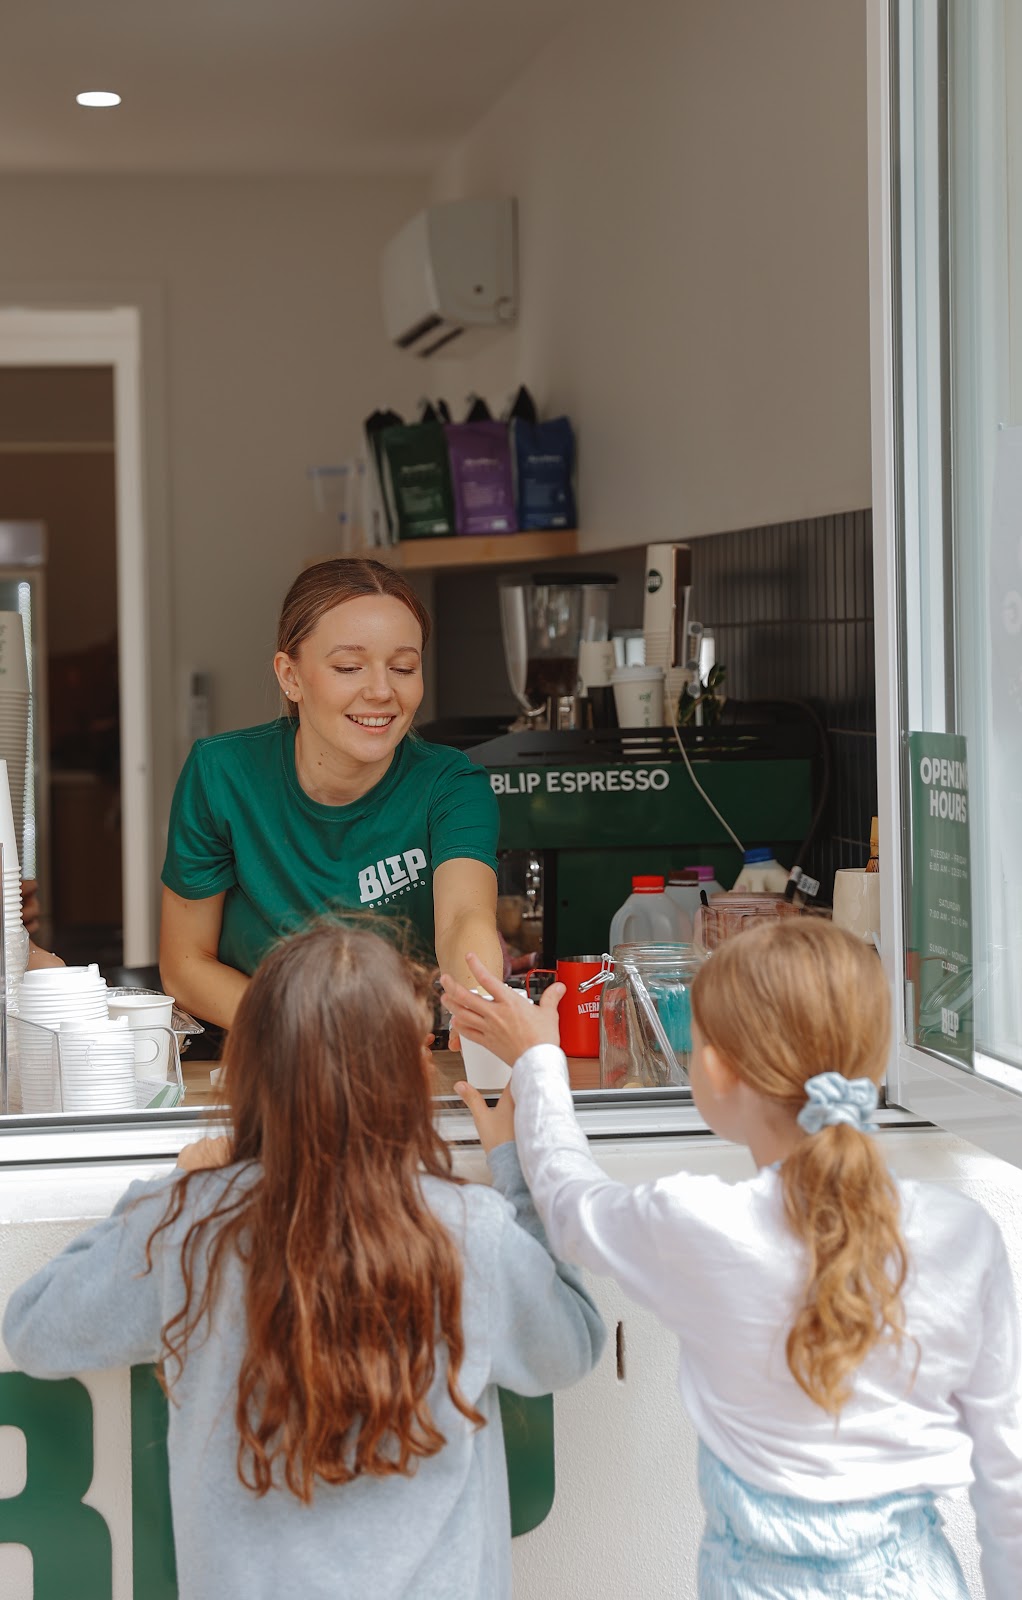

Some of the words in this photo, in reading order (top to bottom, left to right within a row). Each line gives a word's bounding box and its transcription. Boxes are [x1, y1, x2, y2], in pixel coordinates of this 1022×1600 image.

[490, 772, 541, 794] BLIP
[546, 768, 670, 794] ESPRESSO
[920, 756, 968, 790] OPENIN
[929, 789, 967, 824] HOURS
[357, 848, 427, 904] BLIP
[369, 880, 426, 909] espresso
[941, 960, 958, 974] CLOSED
[941, 1006, 959, 1039] BLIP
